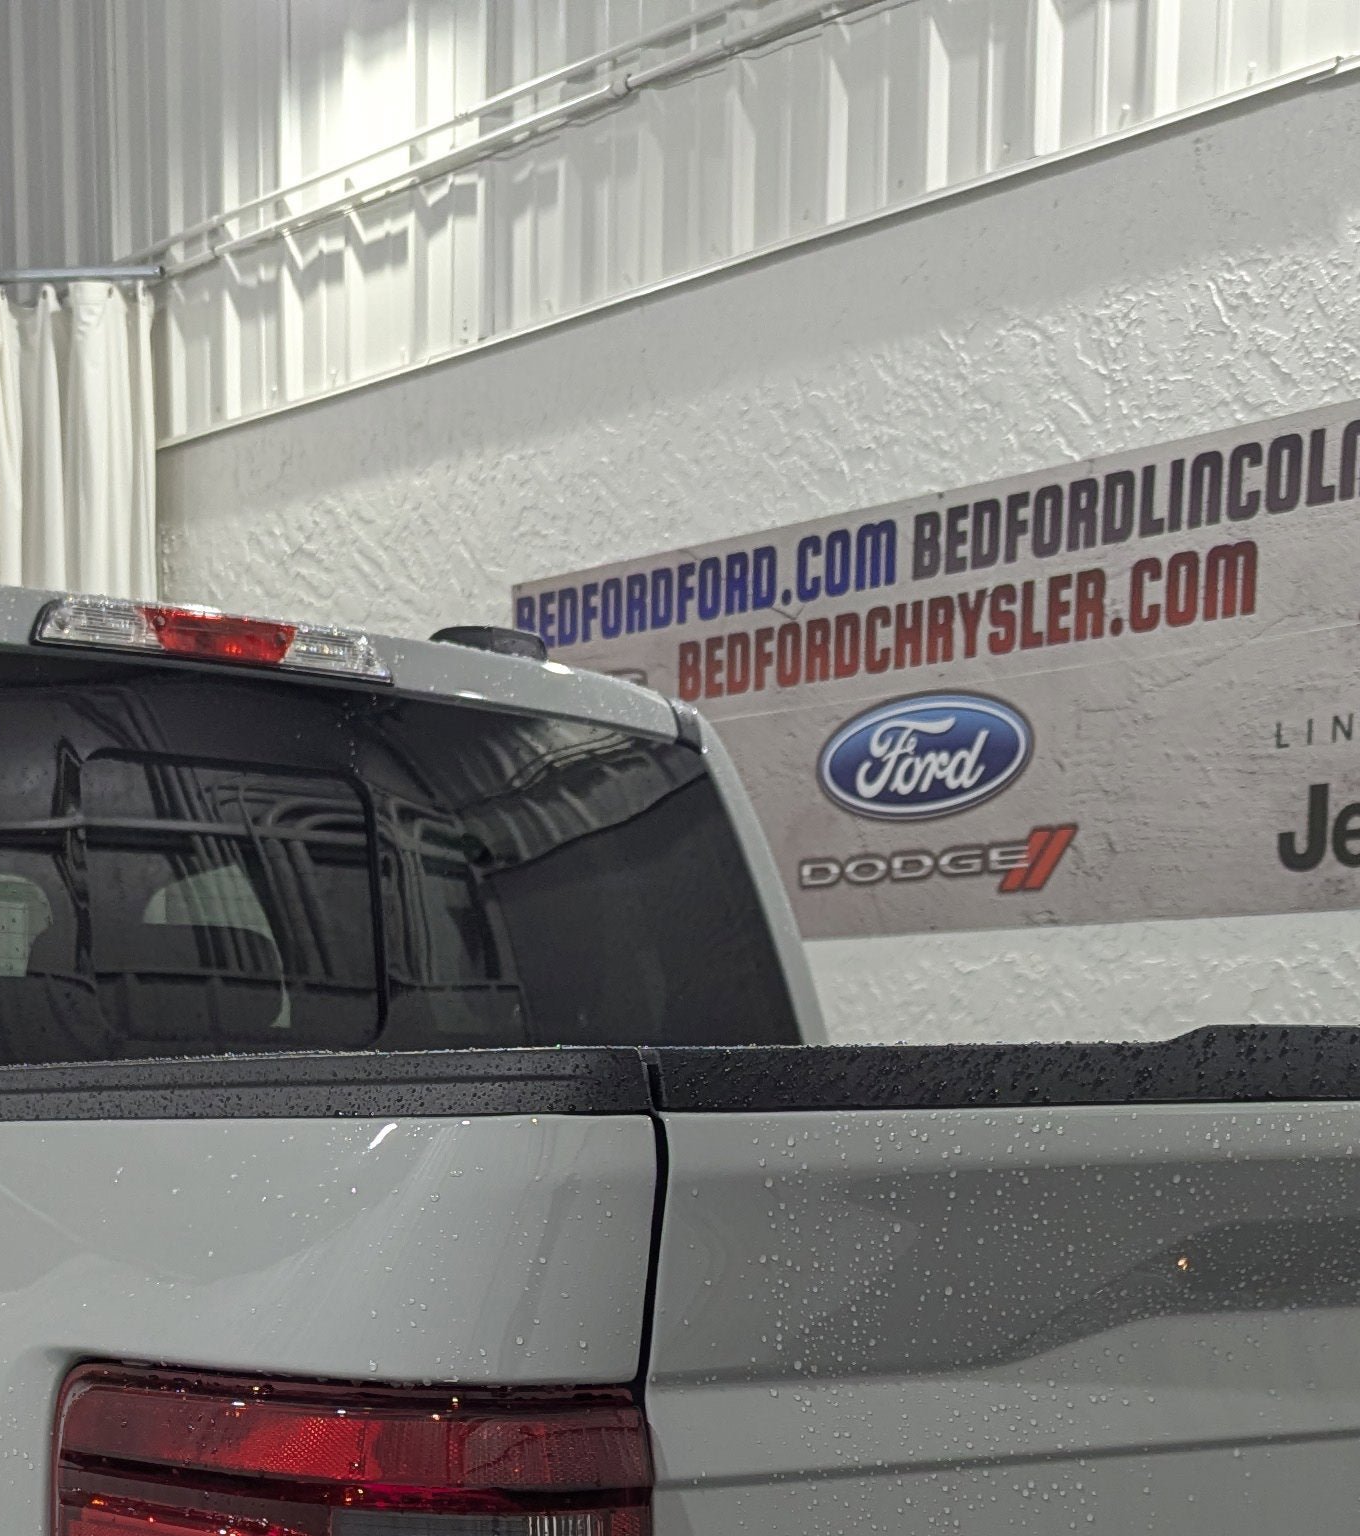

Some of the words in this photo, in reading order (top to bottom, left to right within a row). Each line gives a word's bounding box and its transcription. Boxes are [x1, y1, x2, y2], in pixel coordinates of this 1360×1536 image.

[516, 518, 897, 650] BEDFORDFORD.COM
[678, 540, 1258, 701] BEDFORDCHRYSLER.COM
[855, 715, 990, 800] Ford
[798, 841, 1033, 889] DODGE
